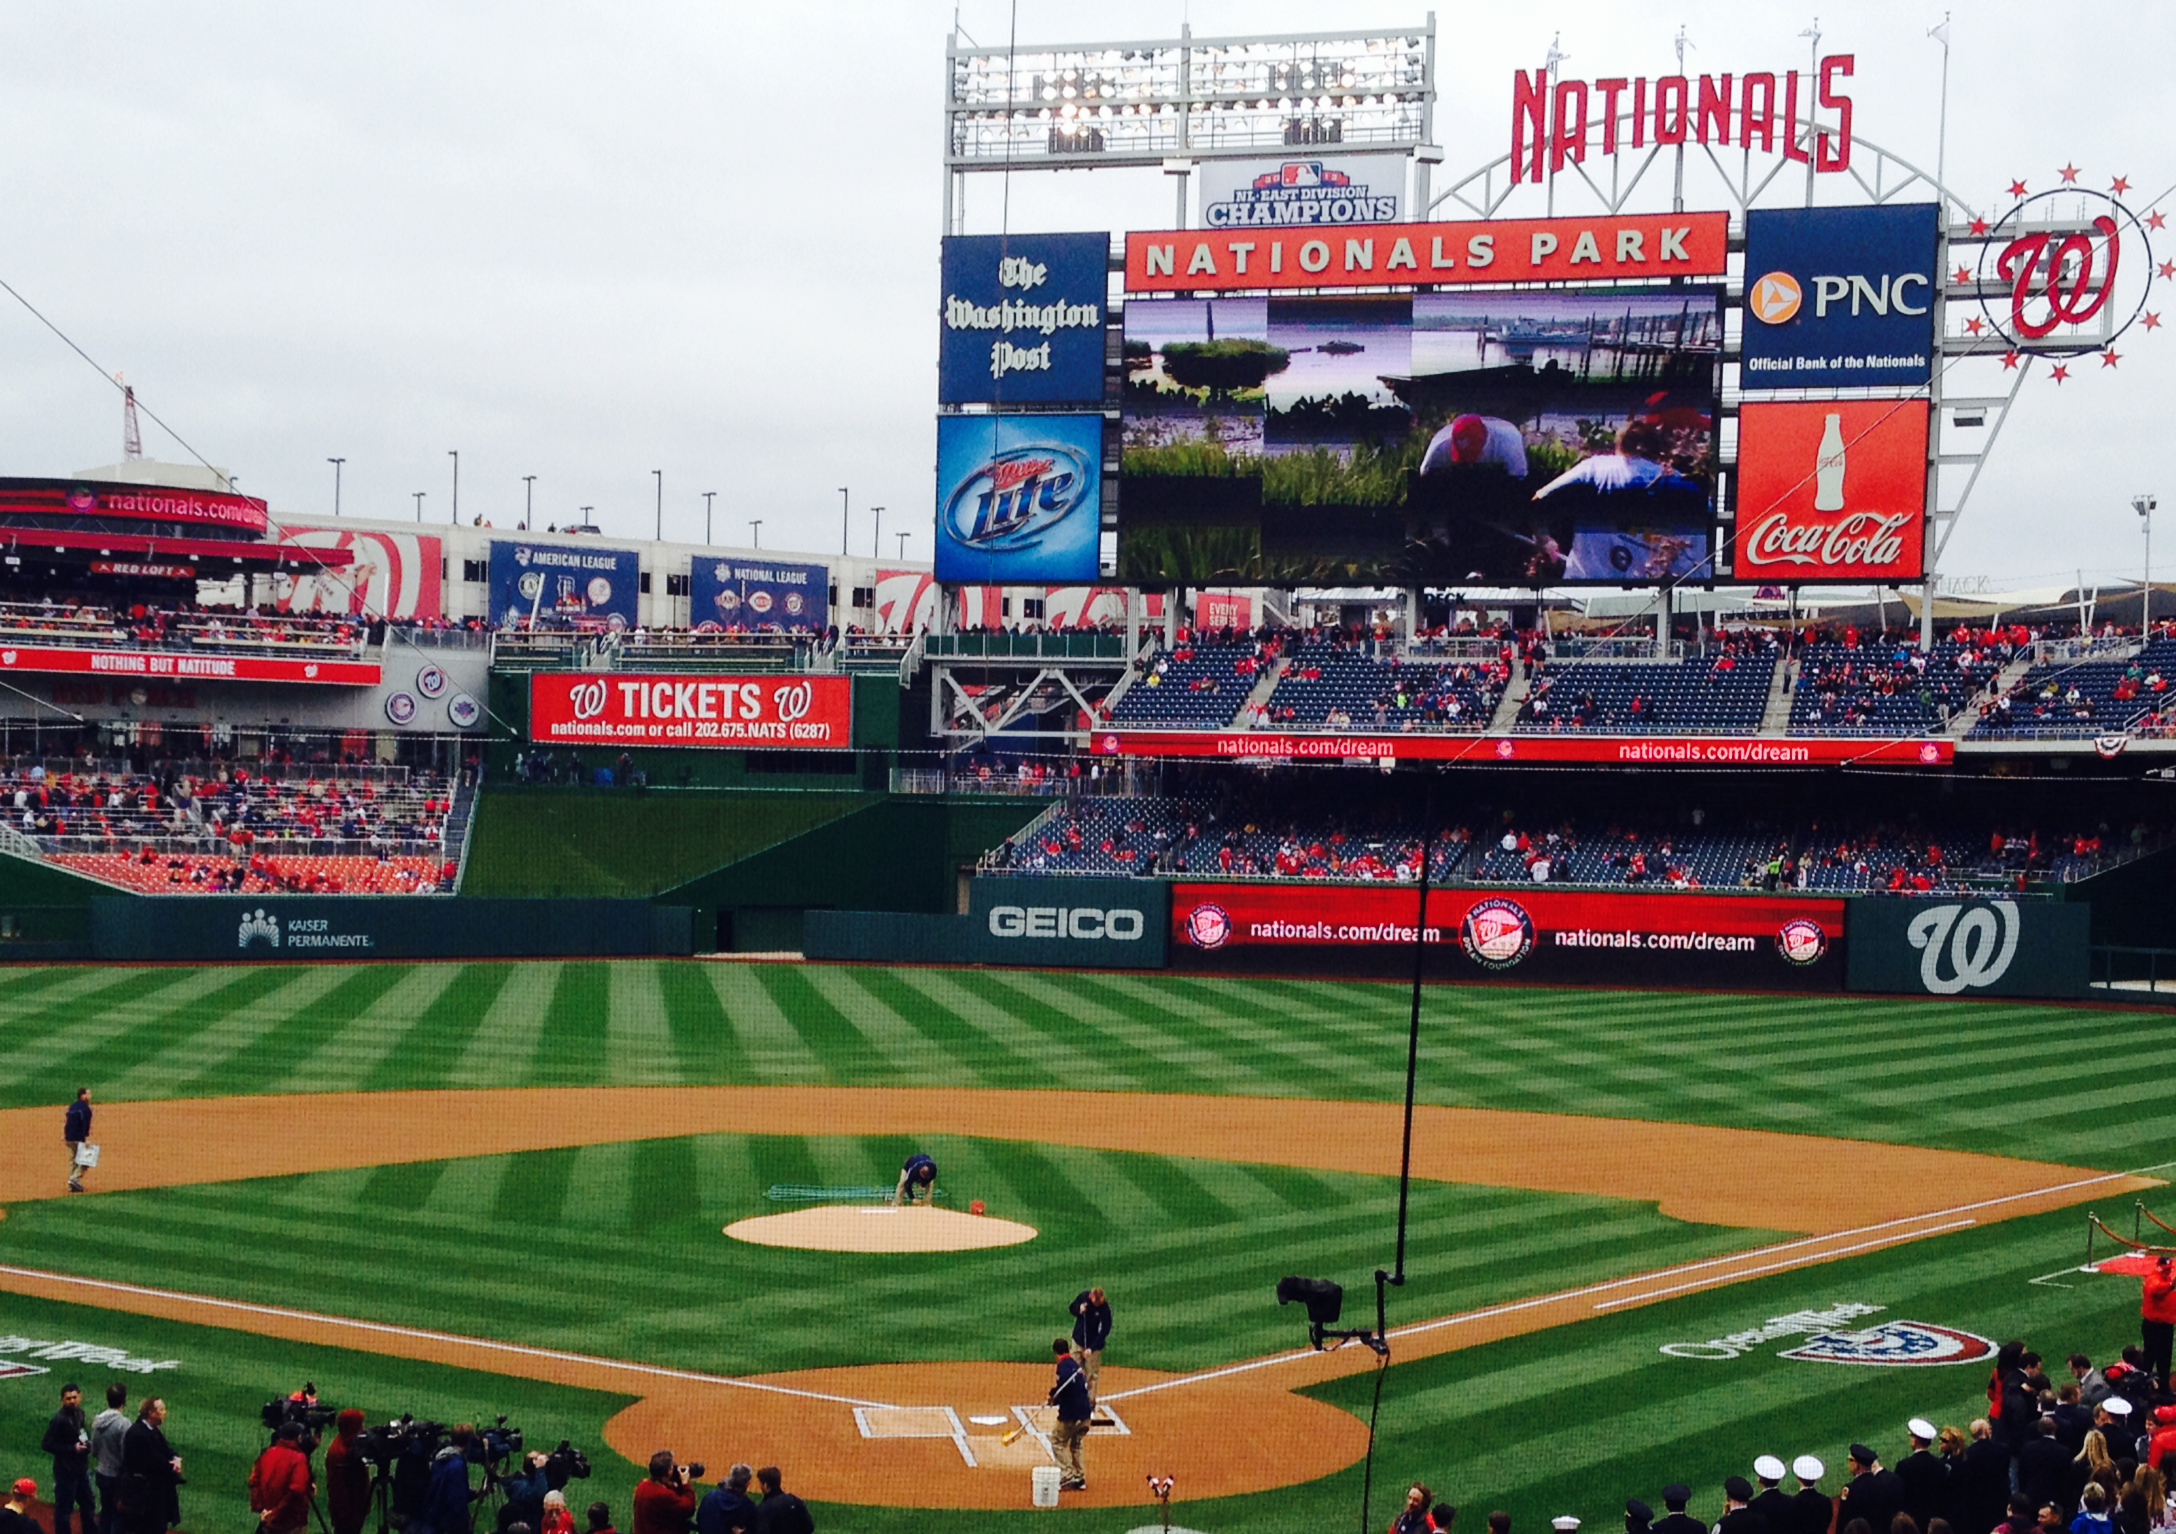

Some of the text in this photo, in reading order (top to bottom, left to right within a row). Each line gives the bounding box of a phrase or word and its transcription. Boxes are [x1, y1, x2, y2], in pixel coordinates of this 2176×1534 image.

[1511, 54, 1855, 184] NATIONALS
[1301, 186, 1368, 200] DIVISION
[1207, 198, 1396, 227] CHAMPIONS
[1147, 227, 1691, 276] NATIONALS PARK
[999, 256, 1048, 291] The
[1811, 272, 1929, 317] PNC
[944, 293, 1100, 335] Washington
[990, 341, 1051, 380] Post
[1749, 353, 1926, 370] Official Bank of the Nationals
[967, 471, 1076, 543] Lite
[1747, 512, 1915, 566] Coca-Cola
[532, 551, 617, 571] AMERICAN LEAGUE
[734, 567, 808, 585] NATIONAL LEAGUE
[1424, 592, 1466, 605] DECK
[91, 654, 146, 672] NOTHING
[150, 656, 174, 673] BUT
[177, 658, 236, 676] NATITUDE
[618, 682, 761, 720] TICKETS
[551, 720, 831, 741] nationals.com or call 202.675.NATS (6287)
[1217, 736, 1394, 757] nationals.com/dream
[1619, 743, 1809, 762] nationals.com/dream
[1472, 899, 1525, 919] NATIONALS
[288, 919, 328, 932] KAISER
[988, 905, 1144, 941] GEICO
[1250, 919, 1441, 943] nationals.com/dream
[288, 934, 370, 947] PERMANENTE
[1554, 927, 1756, 952] nationals.com/dream
